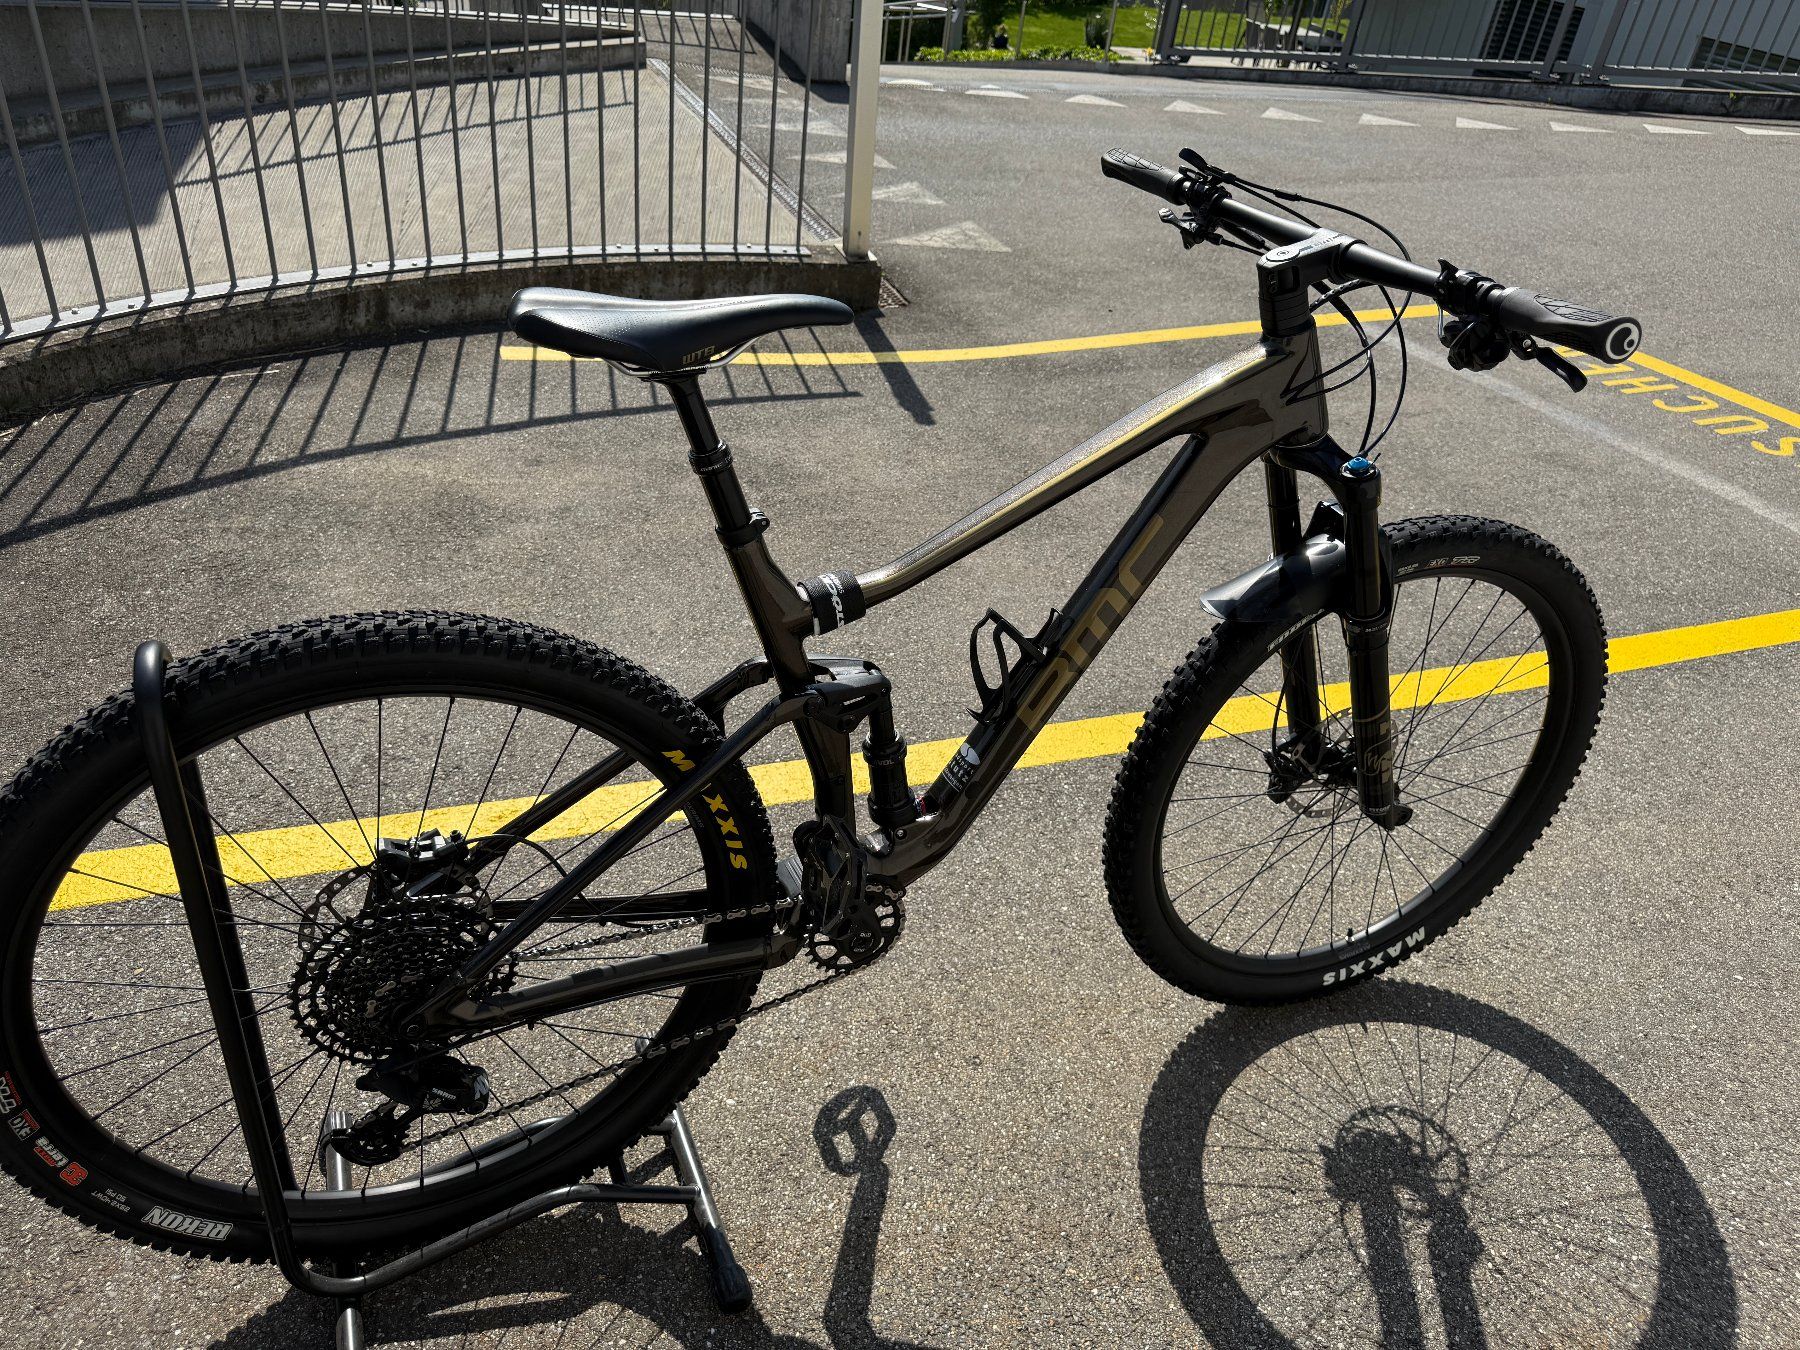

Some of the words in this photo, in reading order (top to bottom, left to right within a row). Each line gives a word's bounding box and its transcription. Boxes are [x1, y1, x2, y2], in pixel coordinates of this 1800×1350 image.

[661, 750, 748, 870] MXXIS
[1322, 926, 1426, 986] MAXXIS
[59, 1161, 89, 1187] 3C
[141, 1205, 234, 1241] REKON
